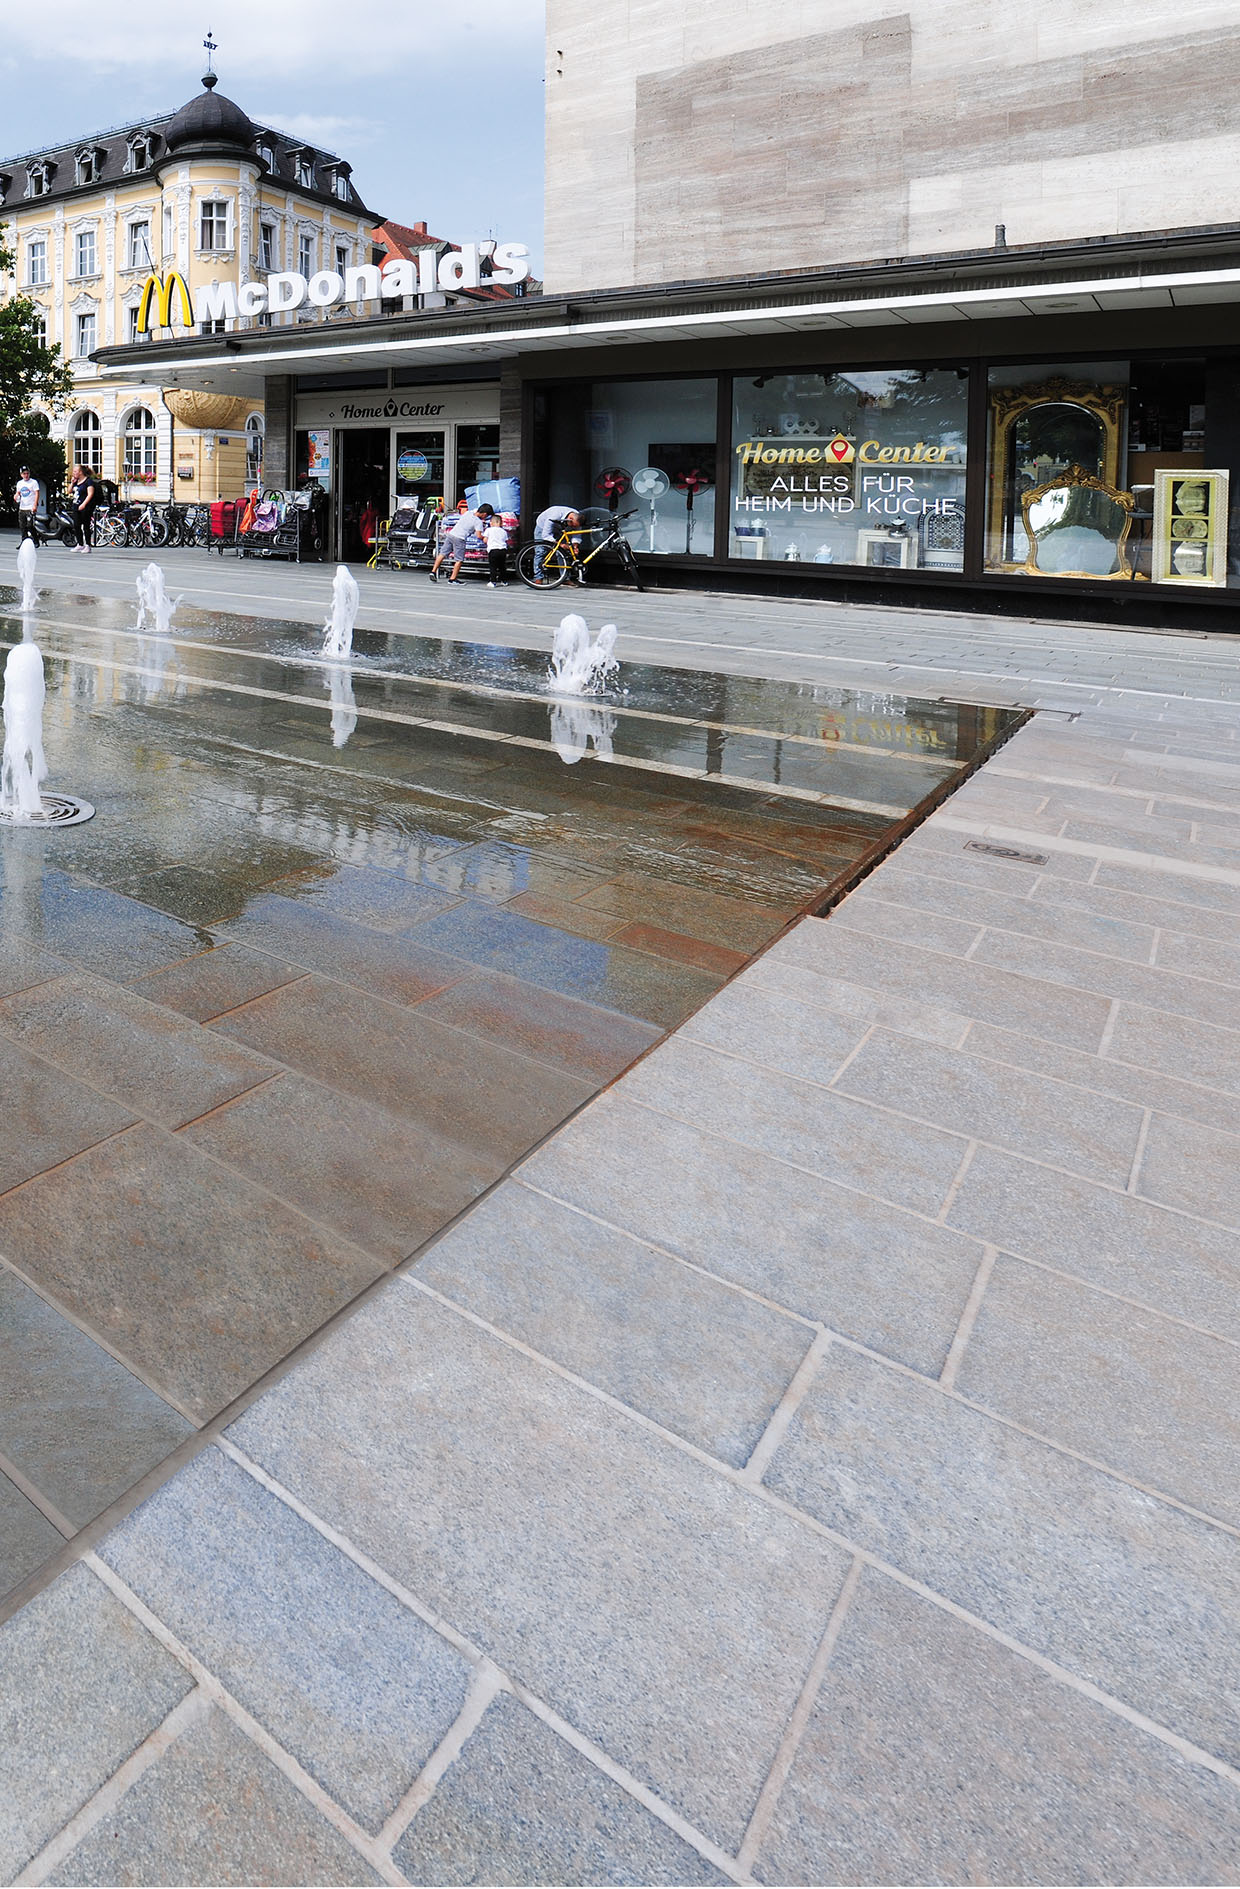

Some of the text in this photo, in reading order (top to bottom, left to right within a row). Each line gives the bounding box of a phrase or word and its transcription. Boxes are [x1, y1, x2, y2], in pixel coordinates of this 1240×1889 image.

[196, 242, 530, 323] McDonald's
[341, 402, 445, 418] Home Center
[736, 440, 956, 464] Home Center
[770, 473, 914, 493] ALLES FÜR
[735, 494, 957, 516] HEIM UND KÜCHE
